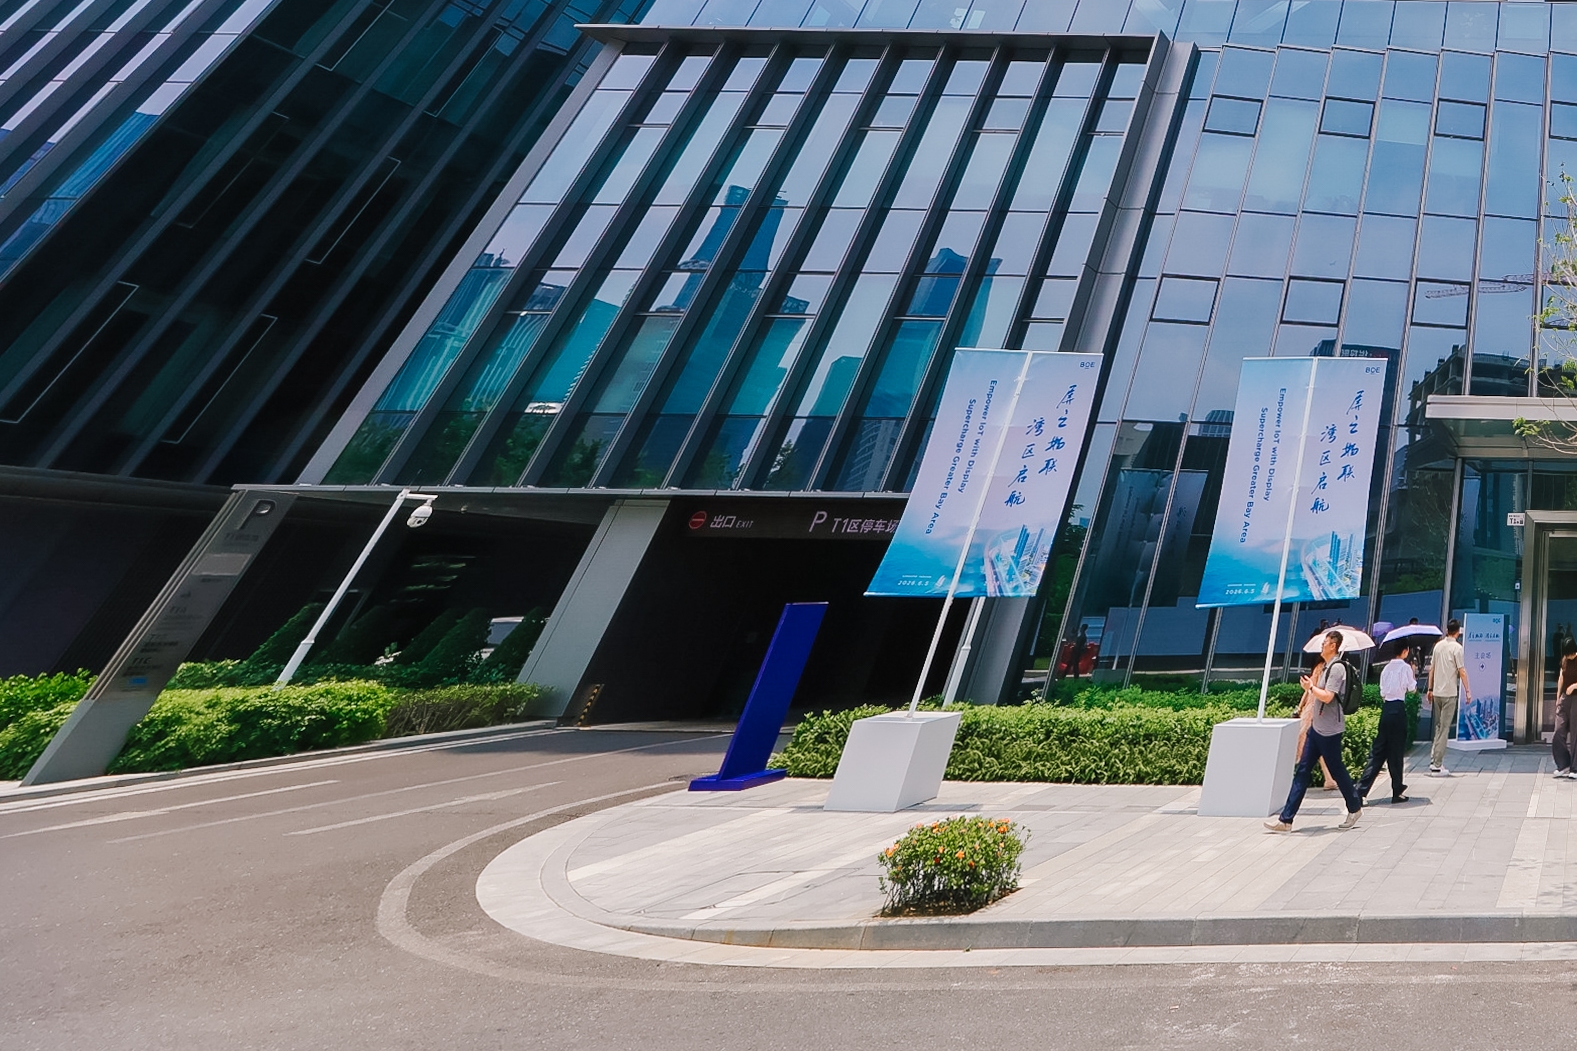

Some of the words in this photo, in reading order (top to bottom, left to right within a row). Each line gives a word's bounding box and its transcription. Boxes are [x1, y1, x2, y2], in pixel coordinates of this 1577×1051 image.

[1079, 361, 1096, 369] BOE
[1365, 366, 1381, 375] BOE
[982, 380, 998, 420] Empower
[1274, 388, 1287, 430] Empower
[954, 399, 977, 453] Supercharge
[977, 421, 987, 436] IoT
[1254, 407, 1269, 463] Supercharge
[971, 437, 982, 458] with
[1272, 430, 1282, 444] IoT
[1004, 416, 1045, 508] 湾区启航
[1269, 446, 1278, 466] with
[943, 454, 960, 491] Greater
[957, 460, 976, 494] Display
[1310, 423, 1338, 514] 湾区启航
[1248, 465, 1261, 499] Greater
[1263, 468, 1276, 502] Display
[935, 492, 948, 510] Bay
[1243, 501, 1254, 519] Bay
[710, 515, 736, 528] 出口
[736, 520, 754, 528] EXIT
[809, 511, 828, 532] P
[832, 518, 899, 533] T1区停车场
[925, 512, 940, 534] Area
[1239, 521, 1250, 543] Area
